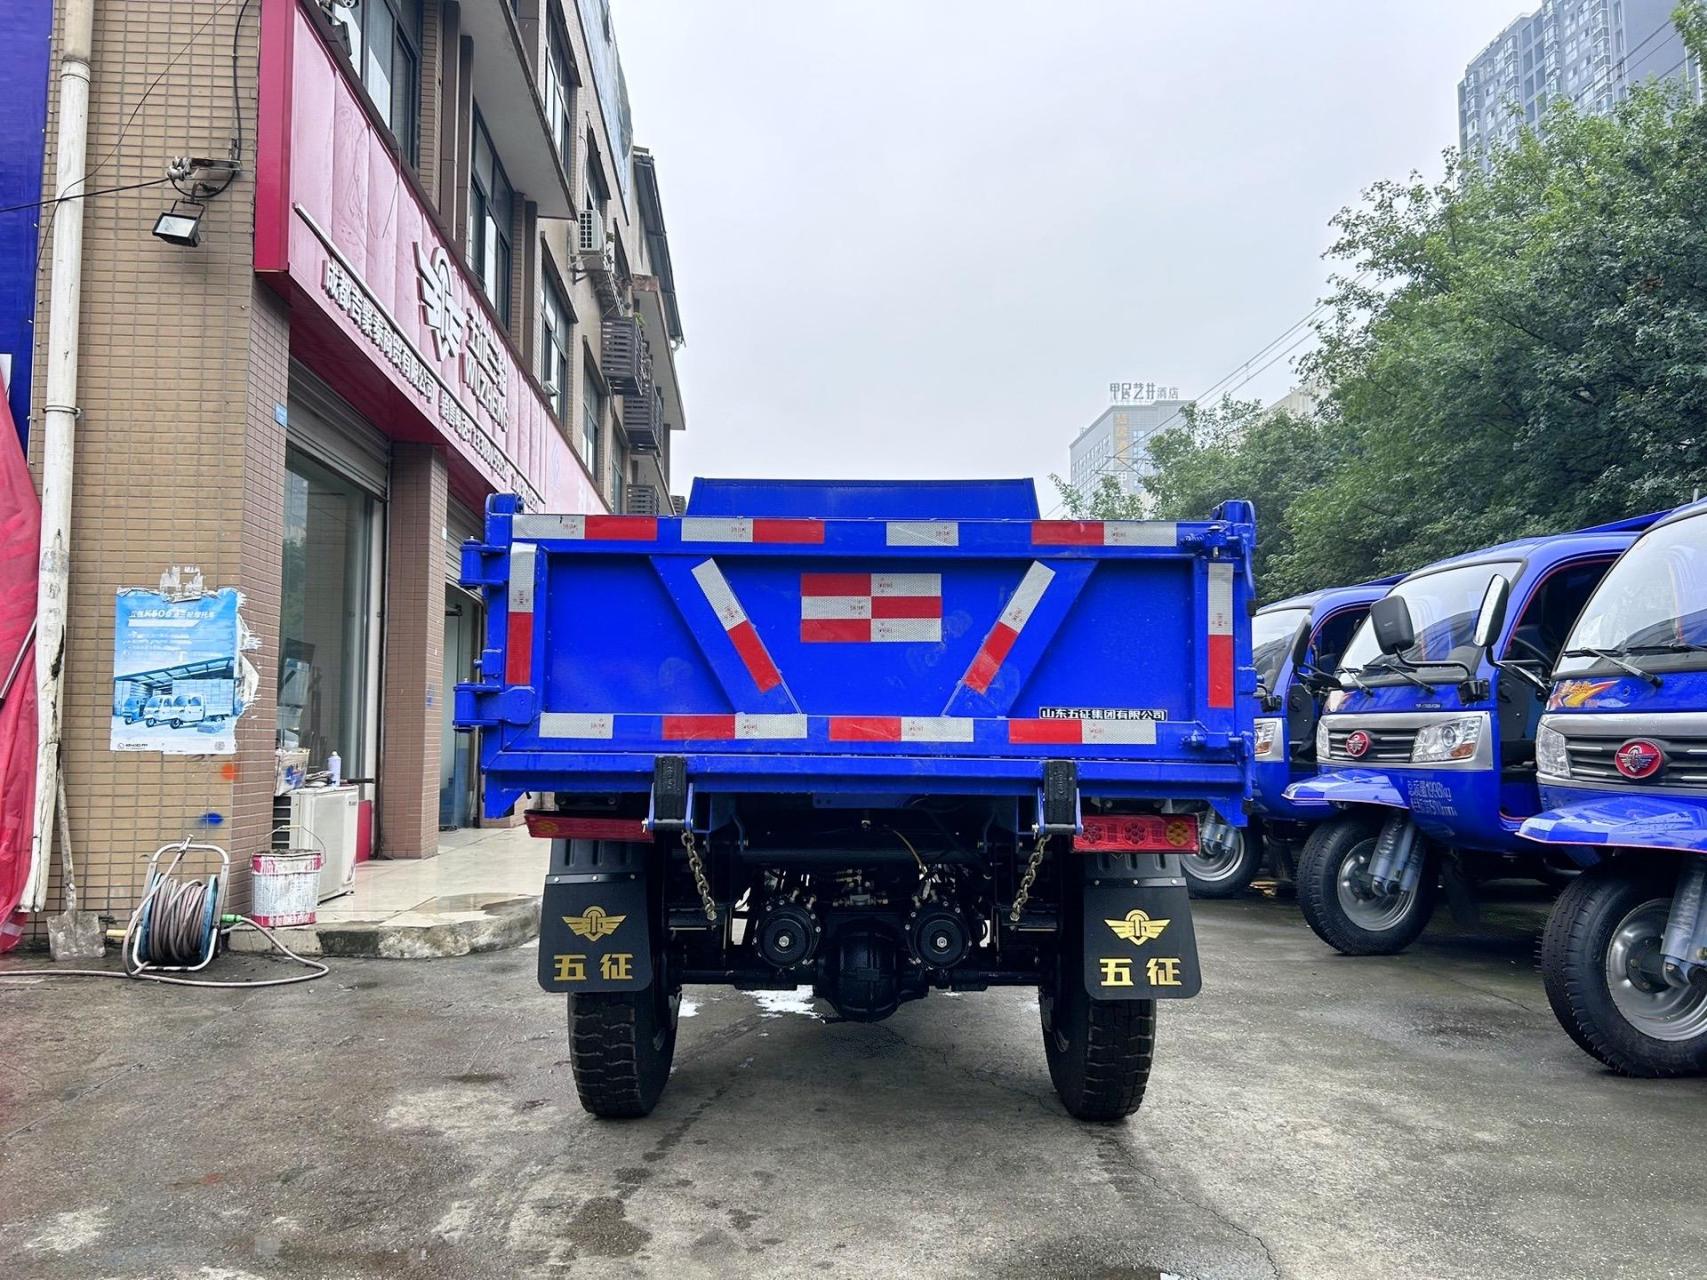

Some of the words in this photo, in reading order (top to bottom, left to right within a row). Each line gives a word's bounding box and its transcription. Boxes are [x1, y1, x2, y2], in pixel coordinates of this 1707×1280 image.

[463, 354, 509, 433] WUZHENG
[1040, 708, 1165, 720] 山东五征集团有限公司
[554, 954, 633, 981] 五征
[1099, 958, 1183, 986] 五征
